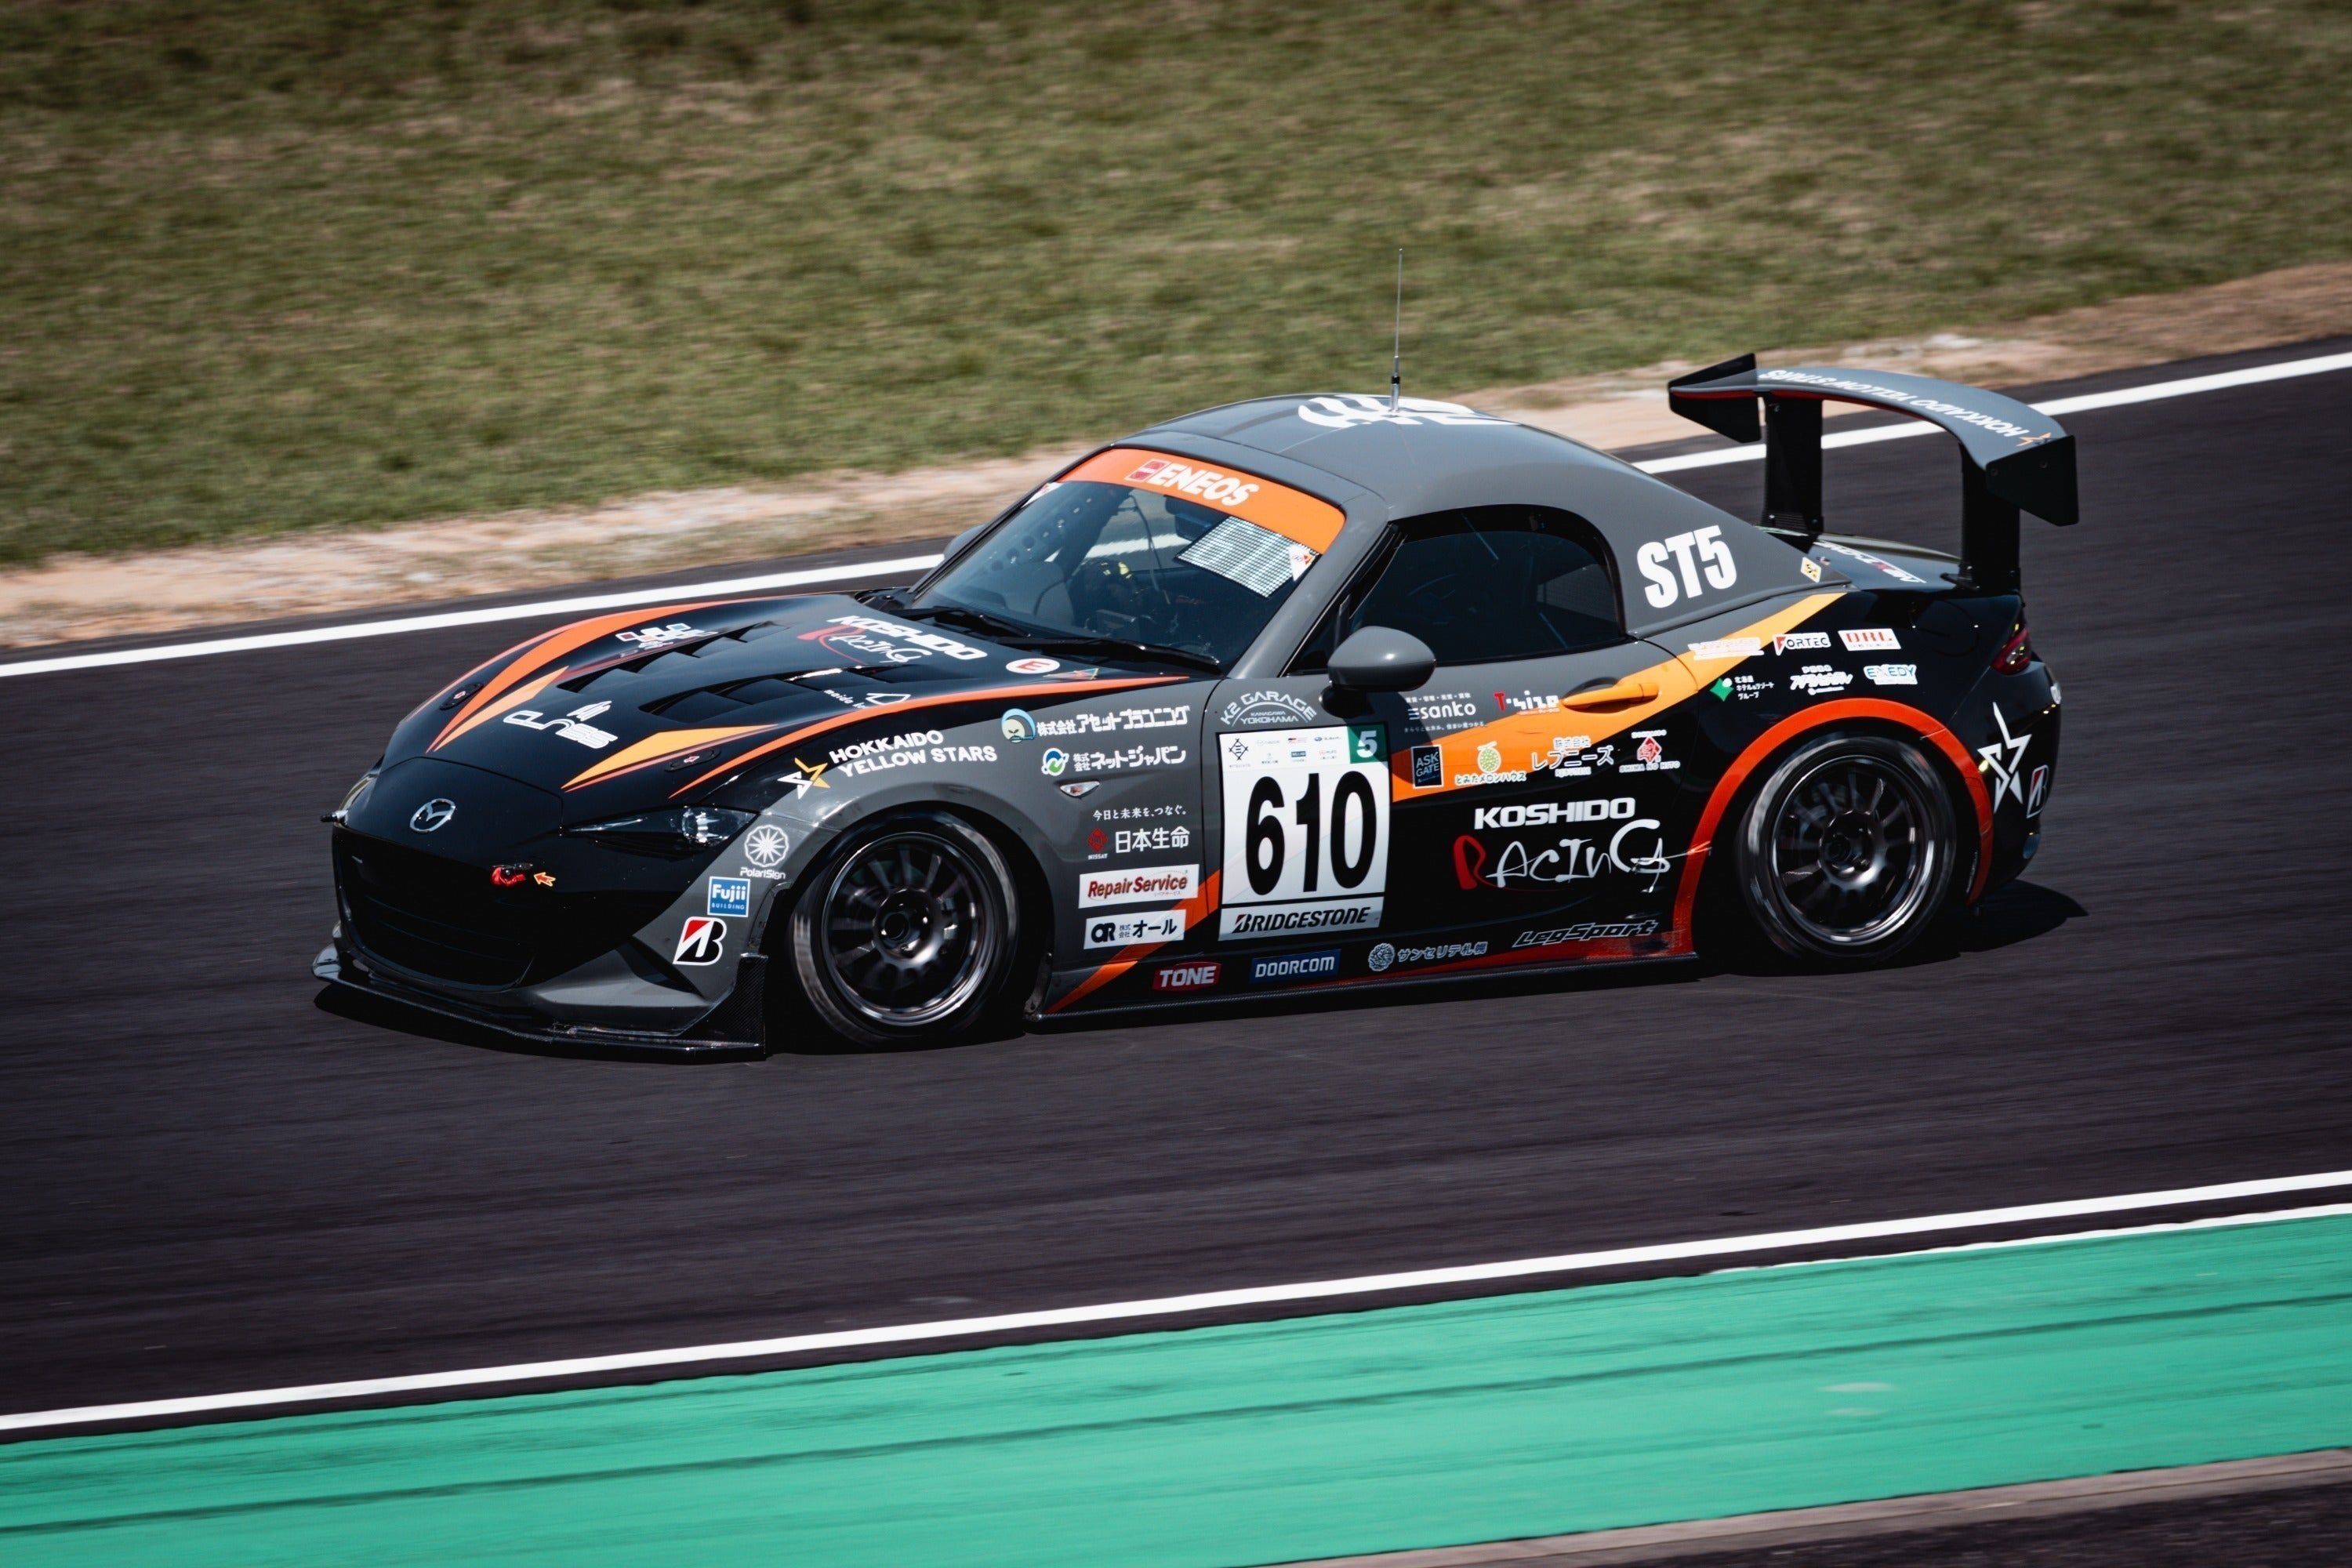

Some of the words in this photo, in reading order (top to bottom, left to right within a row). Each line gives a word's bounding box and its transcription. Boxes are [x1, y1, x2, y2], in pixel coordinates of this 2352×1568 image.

[1147, 463, 1259, 506] ENEOS
[1636, 524, 1737, 608] ST5
[826, 615, 988, 659] KOSHIDO
[1775, 636, 1831, 652] FORTEC
[1867, 667, 1915, 677] EXEDY
[1220, 702, 1241, 725] K2
[1240, 691, 1317, 721] GARAGE
[1420, 701, 1476, 719] sanko
[1240, 716, 1299, 724] YOKOHAMA
[829, 730, 943, 764] HOKKAIDO
[1356, 730, 1377, 758] 5
[837, 750, 926, 778] YELLOW
[932, 746, 997, 763] STARS
[1091, 746, 1186, 770] ネットジャパン
[1416, 752, 1439, 768] ASK
[1619, 764, 1646, 774] SHIMA
[1646, 762, 1659, 771] NO
[1416, 763, 1440, 777] GATE
[1455, 771, 1526, 786] とみたメロンハウス
[1093, 805, 1187, 821] 今日と未来を、つなぐ。
[1474, 797, 1635, 829] KOSHIDO
[1115, 826, 1190, 854] 日本生命
[1246, 771, 1377, 895] 610
[712, 884, 746, 902] Fujii
[1132, 919, 1178, 938] オール
[1231, 906, 1371, 934] BRIDGESTONE
[1512, 920, 1658, 948] LegSport
[1398, 942, 1488, 962] サンセリテ札幌
[1159, 964, 1217, 987] TONE
[1255, 955, 1336, 977] DOORCOM
